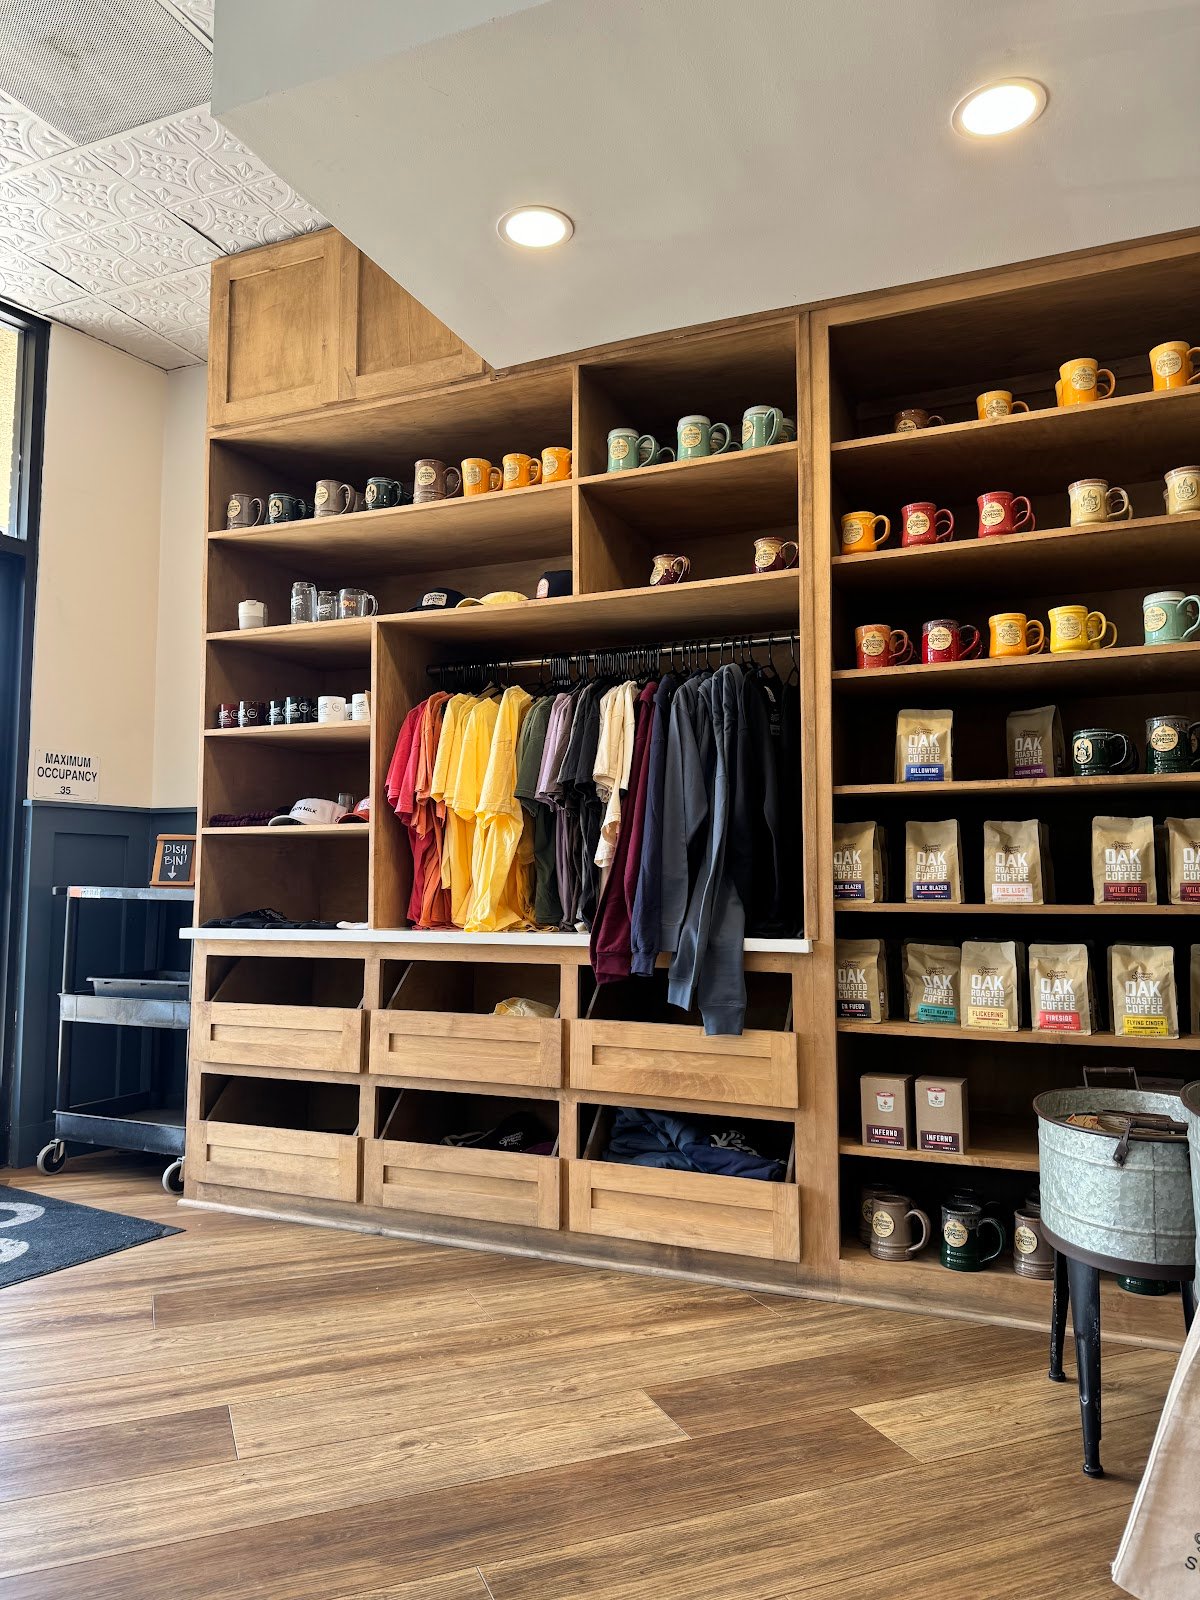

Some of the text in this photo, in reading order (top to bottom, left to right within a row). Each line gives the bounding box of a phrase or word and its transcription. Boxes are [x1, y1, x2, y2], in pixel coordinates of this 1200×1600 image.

[908, 734, 940, 748] OAK
[1014, 737, 1043, 751] OAK
[908, 754, 940, 763] COFFEE
[1014, 750, 1043, 758] ROASTED
[45, 752, 91, 768] MAXIMUM
[1014, 757, 1043, 767] COFFEE
[37, 766, 98, 782] OCCUPANCY
[60, 786, 71, 795] 35
[164, 844, 187, 855] DISH
[163, 854, 188, 866] BIN!
[833, 850, 862, 865] OAK
[916, 851, 947, 866] OAK
[995, 852, 1029, 867] OAK
[1105, 848, 1141, 864] OAK
[916, 864, 948, 873] ROASTED
[995, 866, 1029, 874] ROASTED
[915, 872, 948, 880] COFFEE
[995, 873, 1029, 882] COFFEE
[1105, 872, 1142, 880] COFFEE
[838, 968, 867, 984] OAK
[921, 974, 953, 990] OAK
[971, 974, 1004, 991] OAK
[1040, 977, 1075, 995] OAK
[924, 987, 954, 997] ROASTED
[971, 989, 1005, 998] ROASTED
[1125, 980, 1162, 997] OAK
[838, 990, 868, 999] COFFEE
[922, 994, 954, 1005] COFFEE
[1040, 993, 1075, 1002] ROASTED
[971, 996, 1005, 1007] COFFEE
[1041, 1001, 1076, 1011] COFFEE
[1125, 997, 1163, 1005] ROASTED
[972, 1010, 1004, 1018] FLICKERING
[1126, 1004, 1164, 1015] COFFEE
[1045, 1014, 1073, 1022] FIRESIDE
[872, 1128, 898, 1137] INFERNO
[926, 1133, 953, 1143] INFERNO
